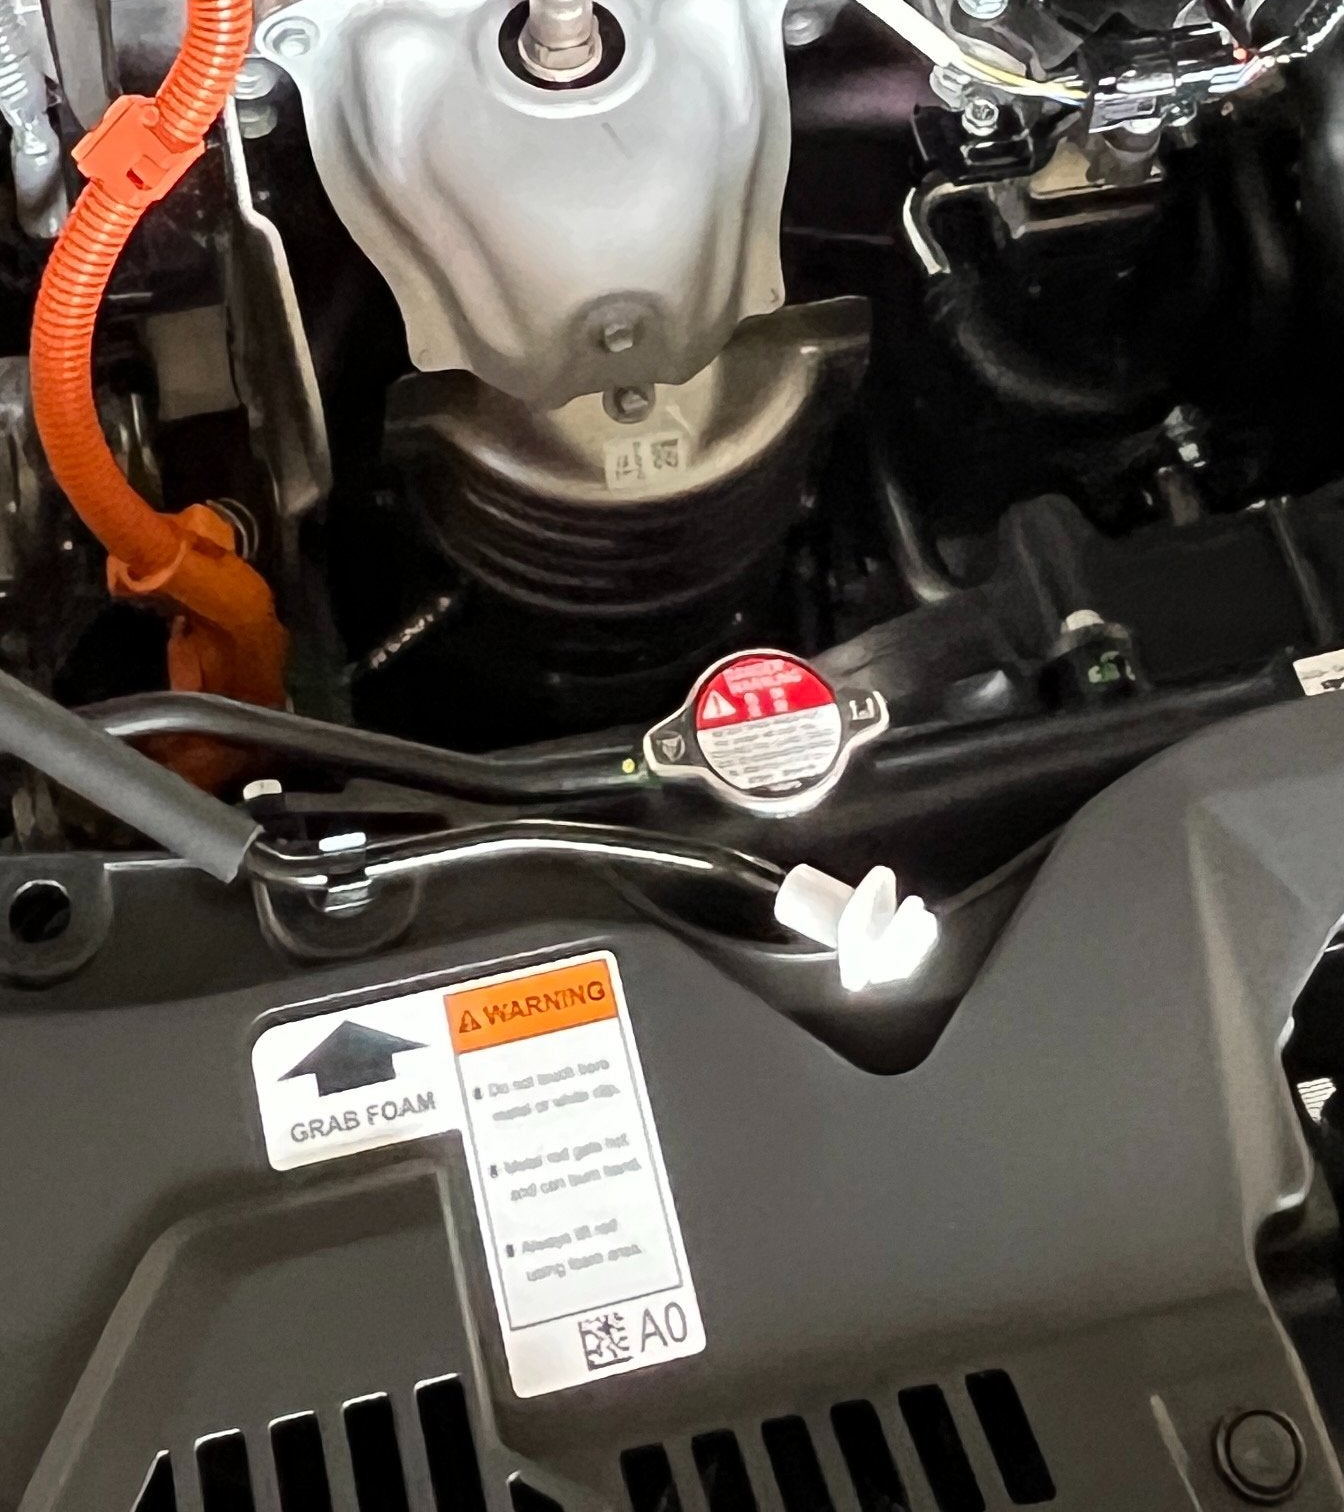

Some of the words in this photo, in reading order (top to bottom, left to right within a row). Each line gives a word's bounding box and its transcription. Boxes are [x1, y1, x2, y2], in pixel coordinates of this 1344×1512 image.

[483, 980, 606, 1026] WARNING
[290, 1110, 361, 1143] GRAB
[365, 1091, 437, 1126] FOAM
[640, 1301, 688, 1353] A0
